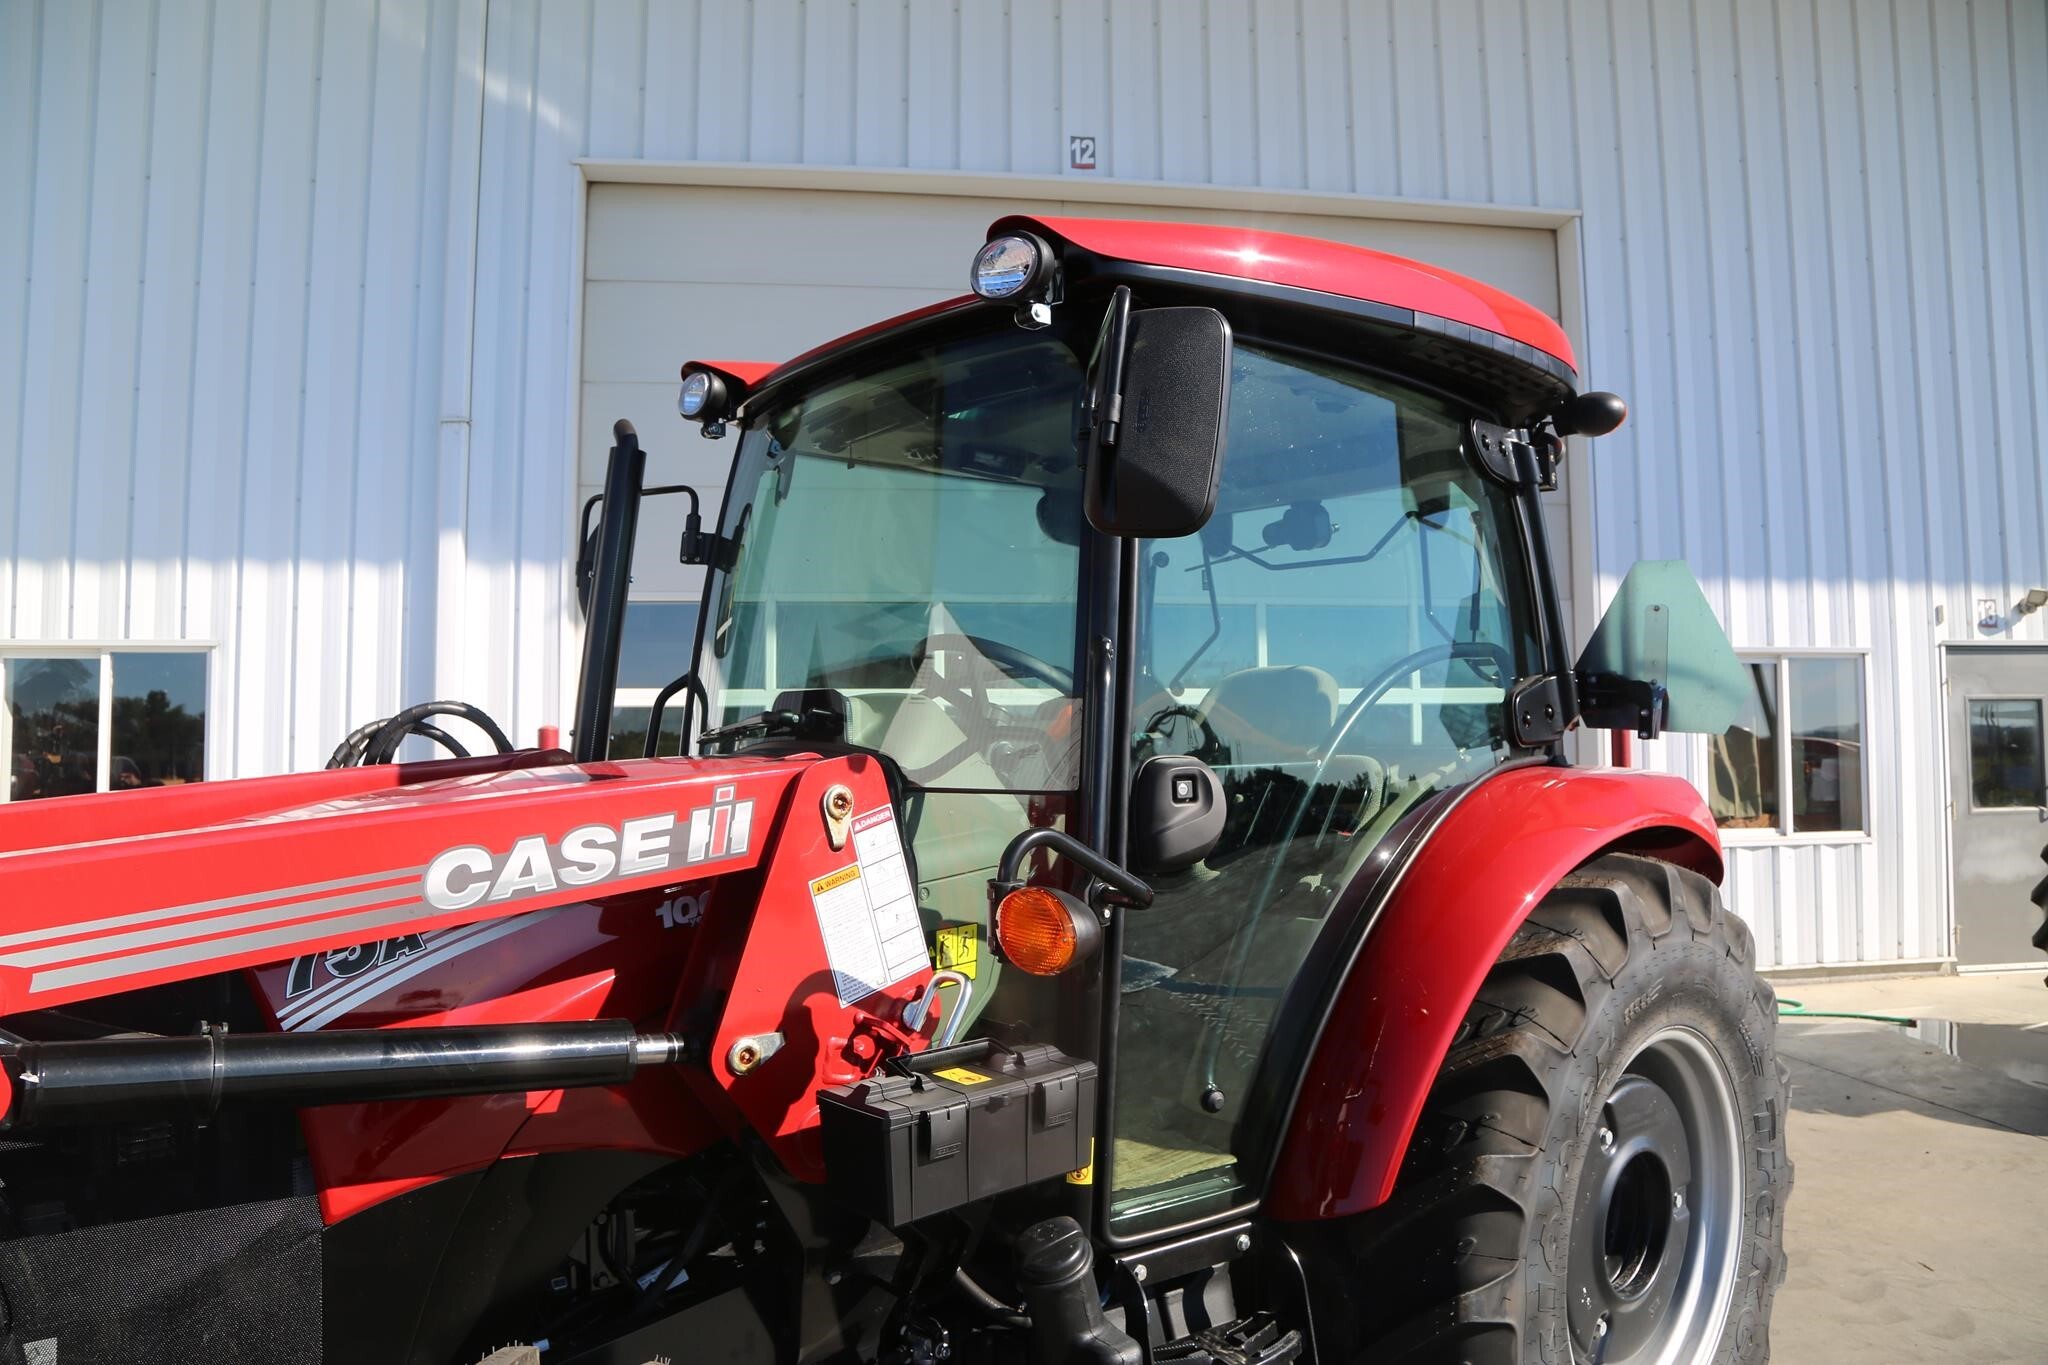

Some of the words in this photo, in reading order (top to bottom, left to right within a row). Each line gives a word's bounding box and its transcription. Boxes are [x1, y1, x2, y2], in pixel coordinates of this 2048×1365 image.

[1071, 138, 1094, 164] 12
[1978, 600, 1996, 625] 13
[861, 810, 891, 828] DANGER
[424, 814, 676, 910] CASE
[824, 869, 857, 888] WARNING
